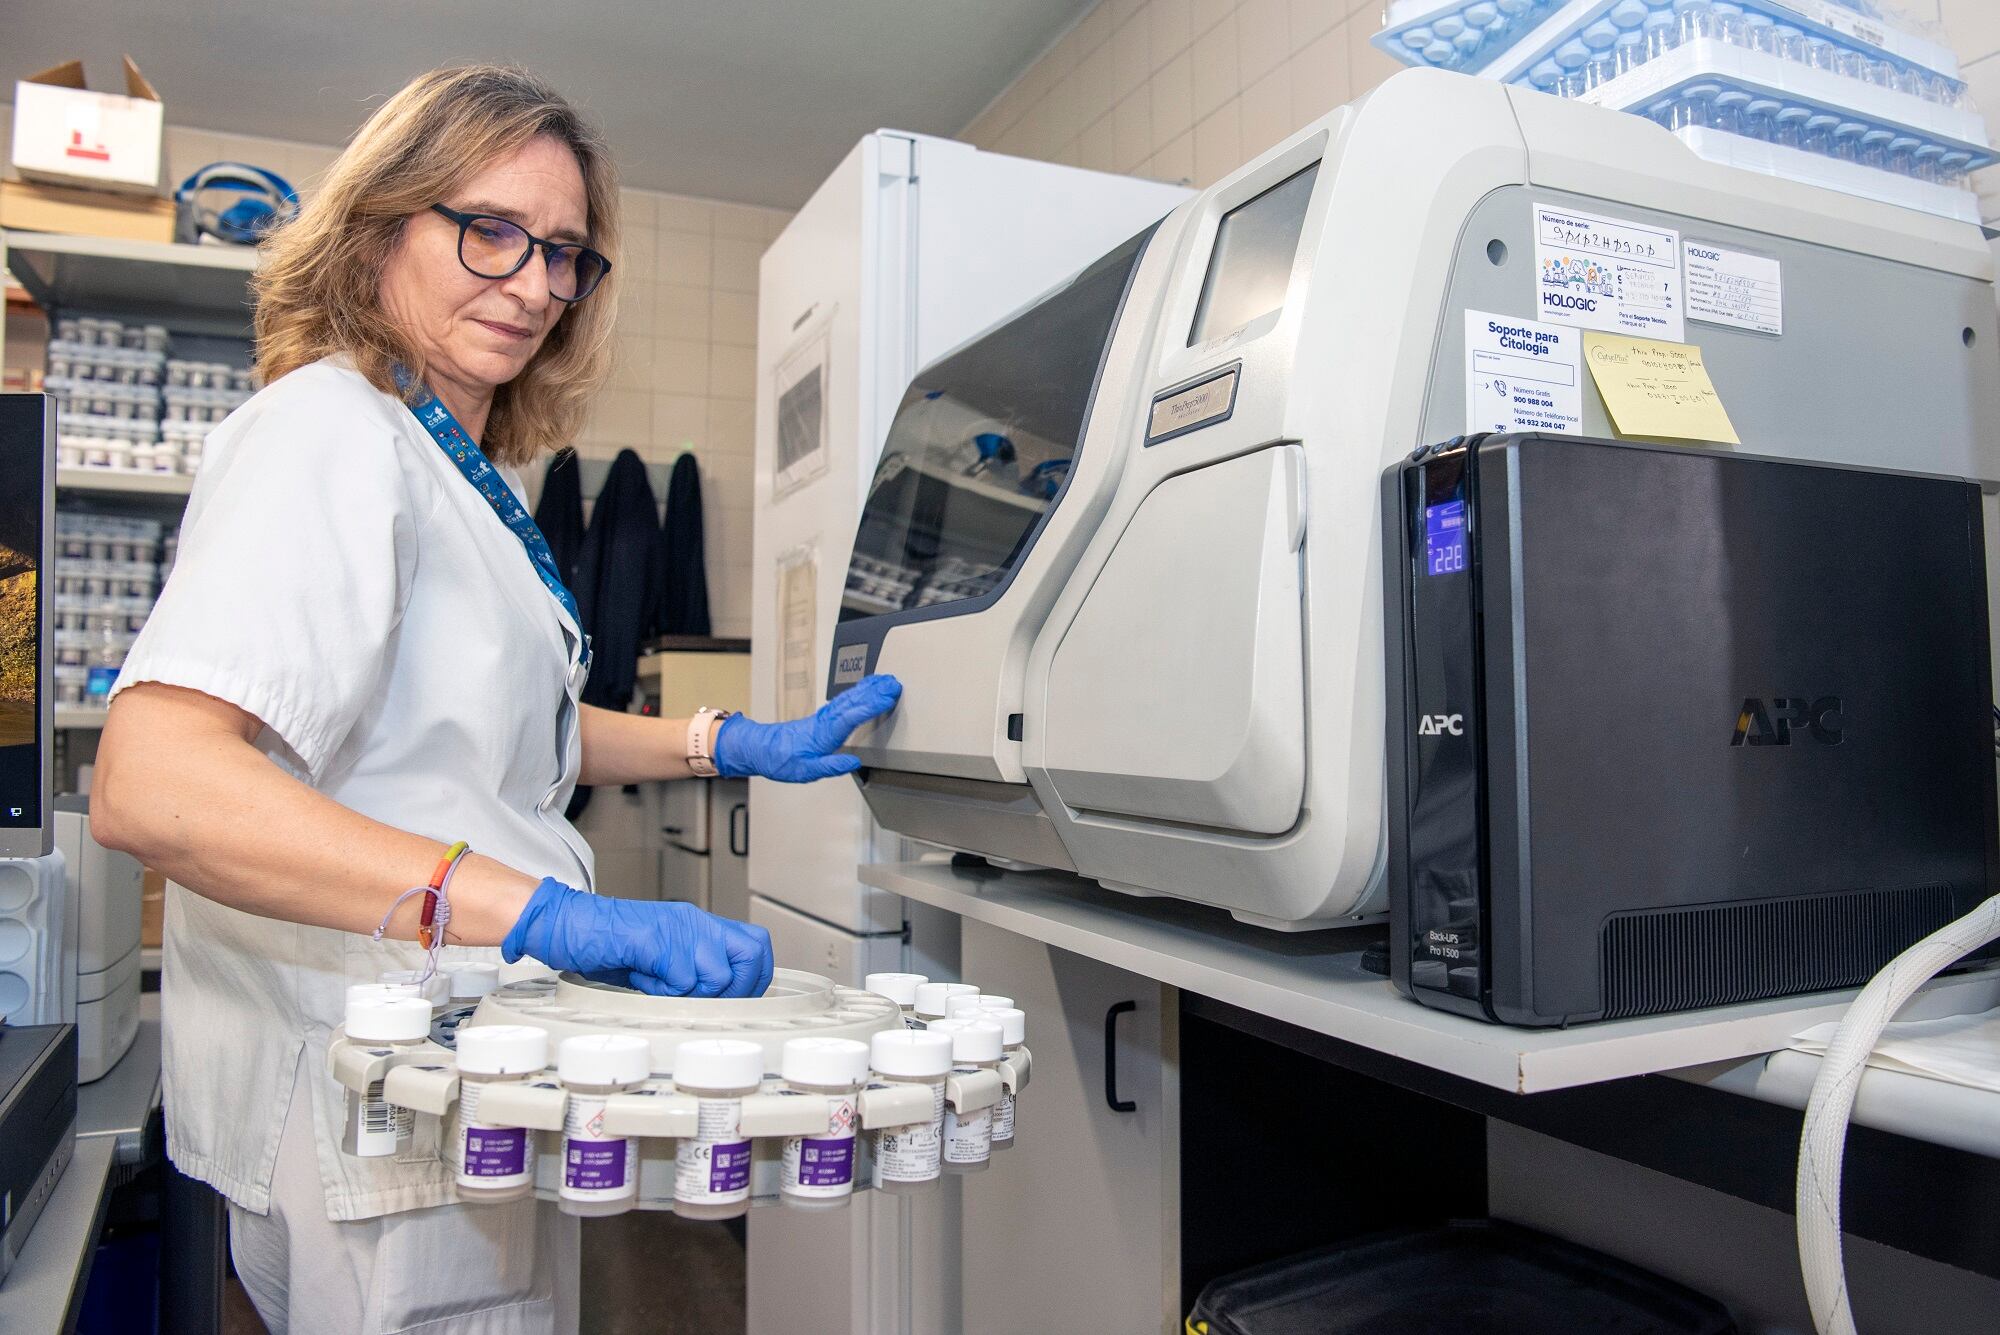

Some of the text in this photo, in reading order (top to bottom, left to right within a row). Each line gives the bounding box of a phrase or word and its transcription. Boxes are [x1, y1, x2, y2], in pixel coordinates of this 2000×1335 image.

[1542, 215, 1566, 225] Número
[1688, 247, 1719, 261] HOLOGIC
[1543, 292, 1596, 312] HOLOGIC
[1622, 320, 1637, 328] marque
[1633, 314, 1650, 322] Soporte
[1489, 321, 1559, 343] Soporte para
[1500, 336, 1549, 355] Citología
[1513, 386, 1534, 395] Número
[1513, 408, 1535, 417] Número
[1544, 412, 1565, 421] Teléfono
[1435, 545, 1462, 573] 228
[840, 655, 863, 673] HOLOGIC
[1418, 713, 1464, 736] APC
[1730, 696, 1844, 747] APC
[1430, 930, 1459, 944] Back-UPS
[1430, 945, 1459, 959] Pro 1500
